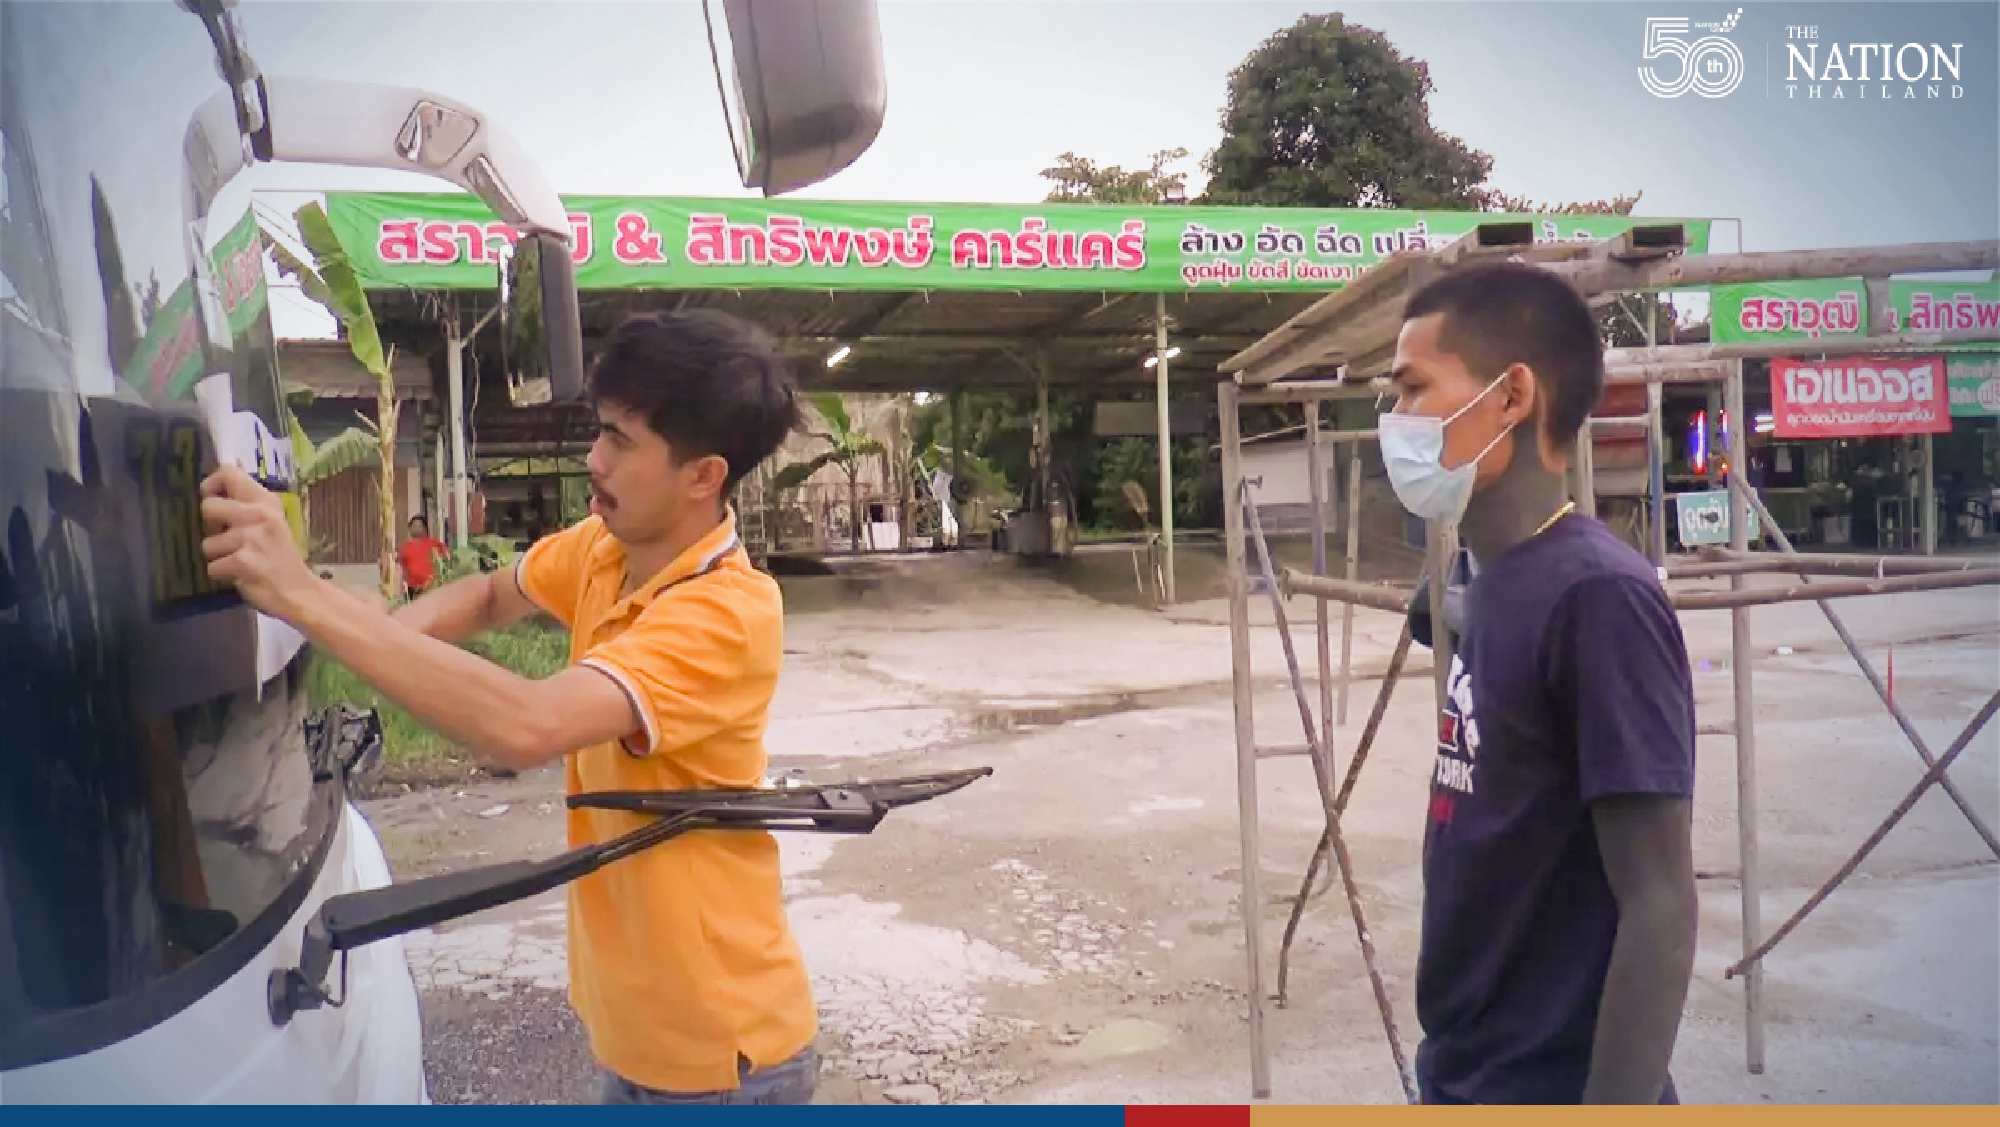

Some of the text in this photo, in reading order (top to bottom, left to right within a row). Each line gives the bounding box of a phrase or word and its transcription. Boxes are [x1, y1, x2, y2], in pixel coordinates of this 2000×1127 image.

[613, 212, 667, 266] &
[687, 212, 934, 267] สิทธิพงษ์
[952, 217, 1146, 269] คาร์แคร์
[1180, 222, 1246, 255] ล้าง
[1255, 223, 1307, 256] อัด
[1181, 259, 1243, 287] ดูดฝุ่น
[1740, 292, 1860, 341] สราวุฒิ
[1784, 364, 1934, 404] เอเนออส
